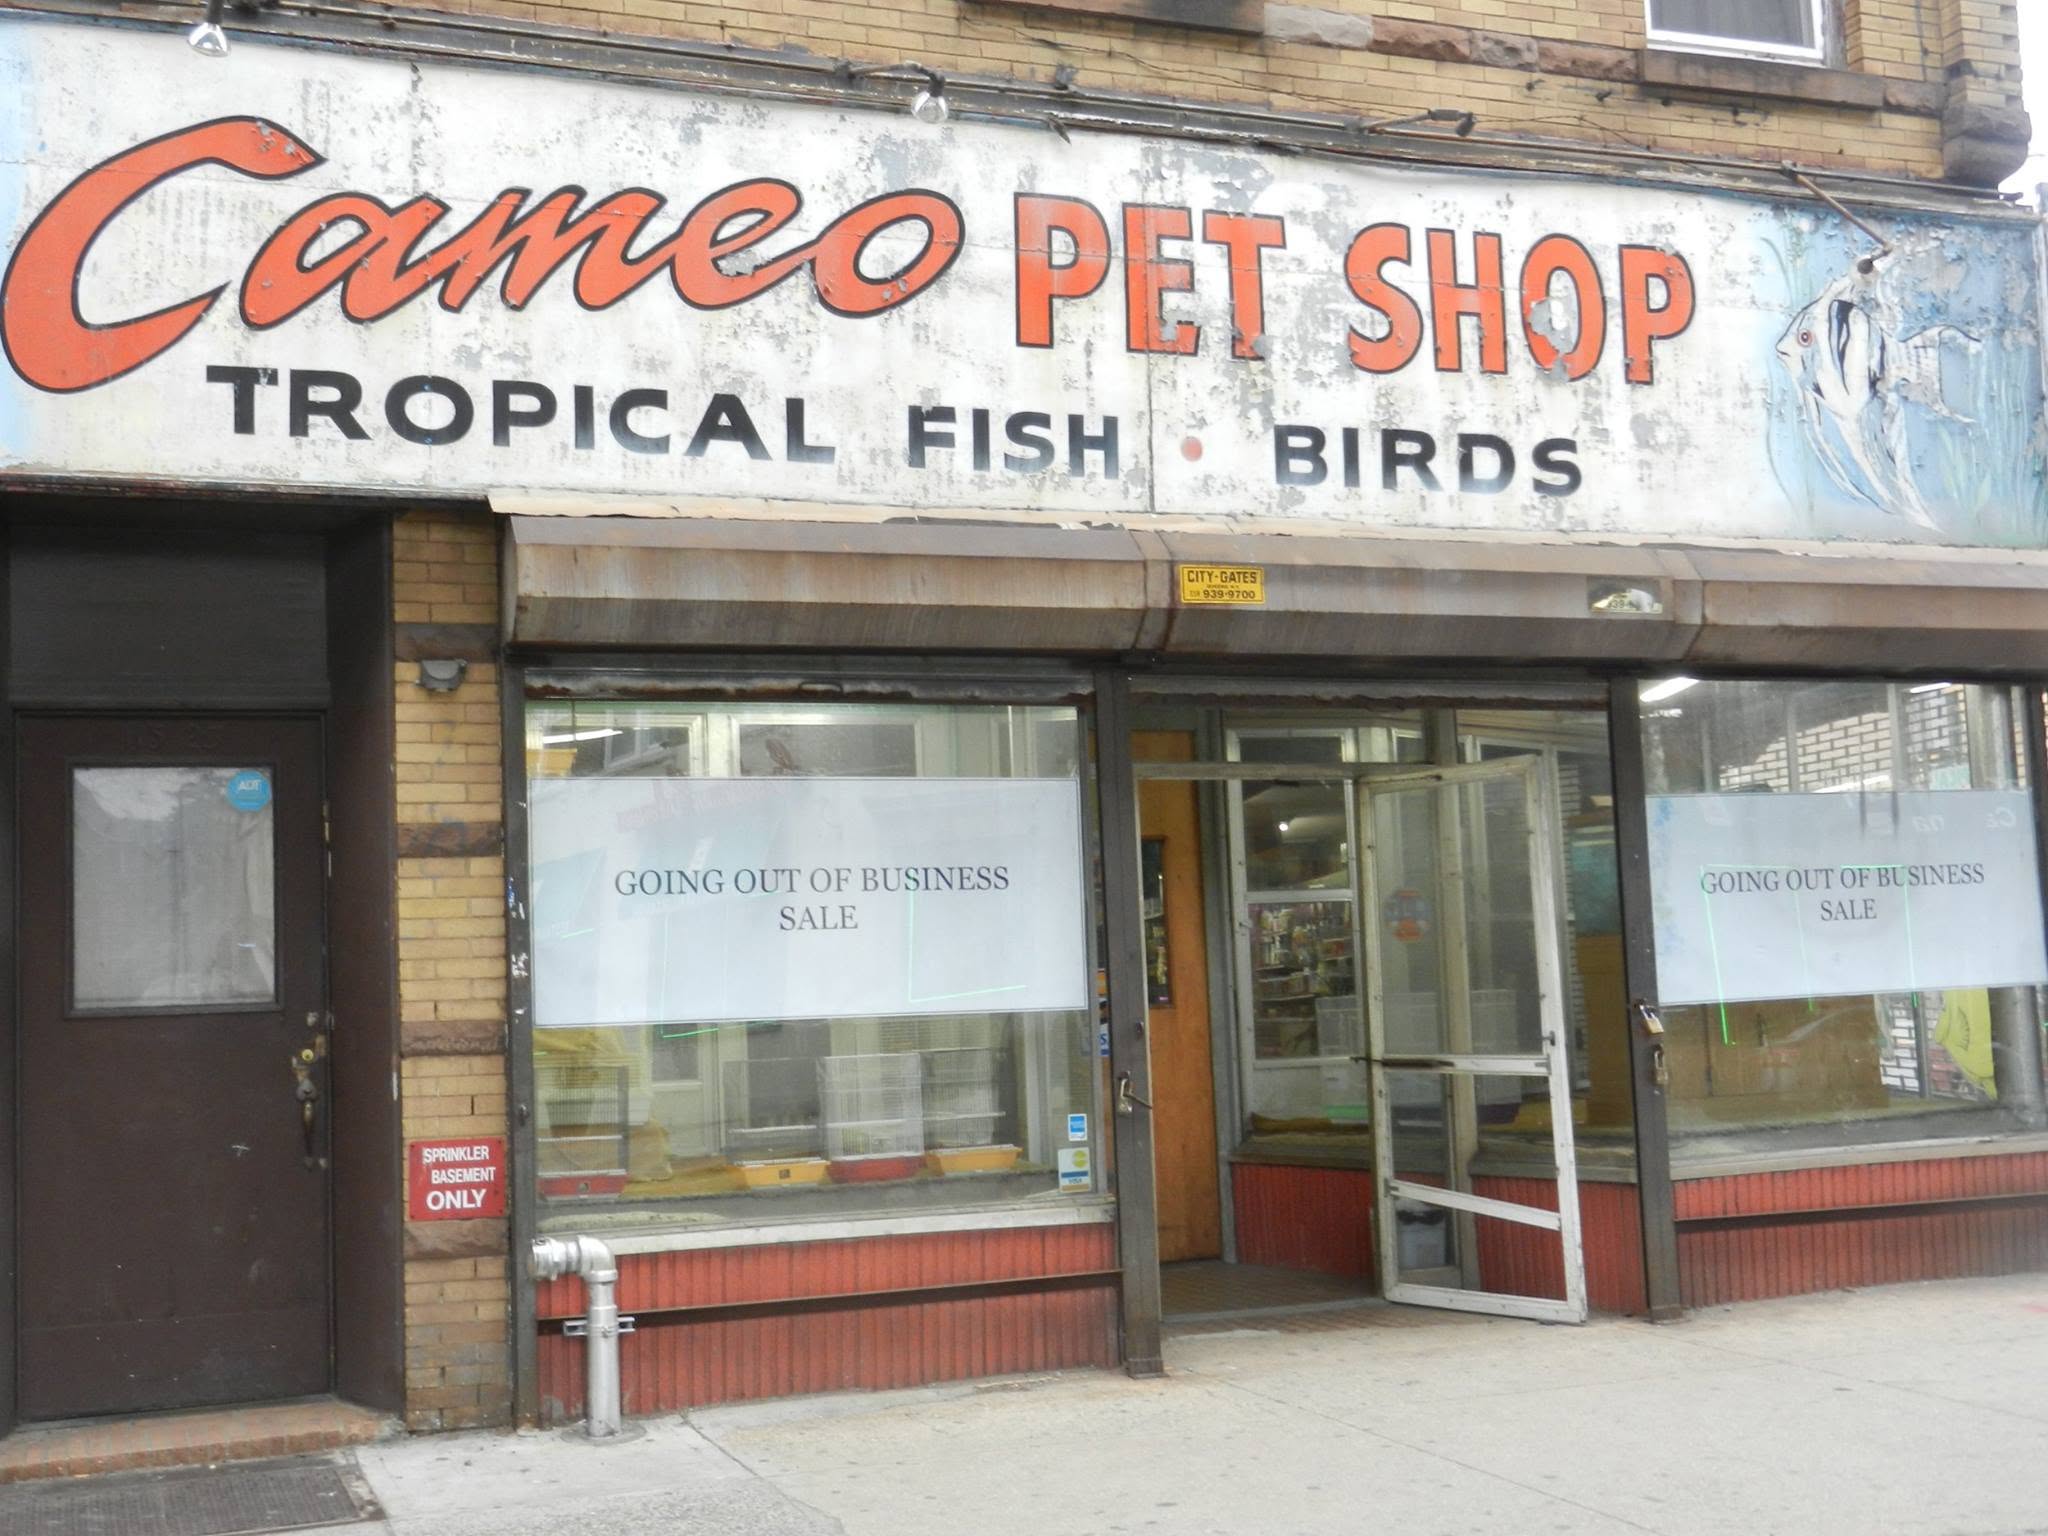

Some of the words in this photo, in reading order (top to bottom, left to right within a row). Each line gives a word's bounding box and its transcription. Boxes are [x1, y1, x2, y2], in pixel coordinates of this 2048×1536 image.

[1, 115, 965, 393] Cameo
[1013, 192, 1286, 361] PET
[1344, 221, 1696, 385] SHOP
[206, 365, 835, 464] TROPICAL
[908, 405, 1118, 480] FISH
[1274, 425, 1582, 496] BIRDS
[1203, 589, 1256, 599] 939-9700
[615, 869, 724, 896] GOING
[734, 868, 801, 894] OUT
[809, 867, 852, 893] OF
[861, 866, 1010, 892] BUSINESS
[1700, 870, 1779, 895] GOING
[1786, 868, 1834, 891] OUT
[1840, 866, 1872, 890] OF
[1878, 863, 1985, 888] BUSINESS
[779, 904, 858, 931] SALE
[1820, 898, 1877, 921] SALE
[423, 1145, 489, 1164] SPRINKLER
[431, 1166, 496, 1184] BASEMENT
[426, 1189, 486, 1211] ONLY
